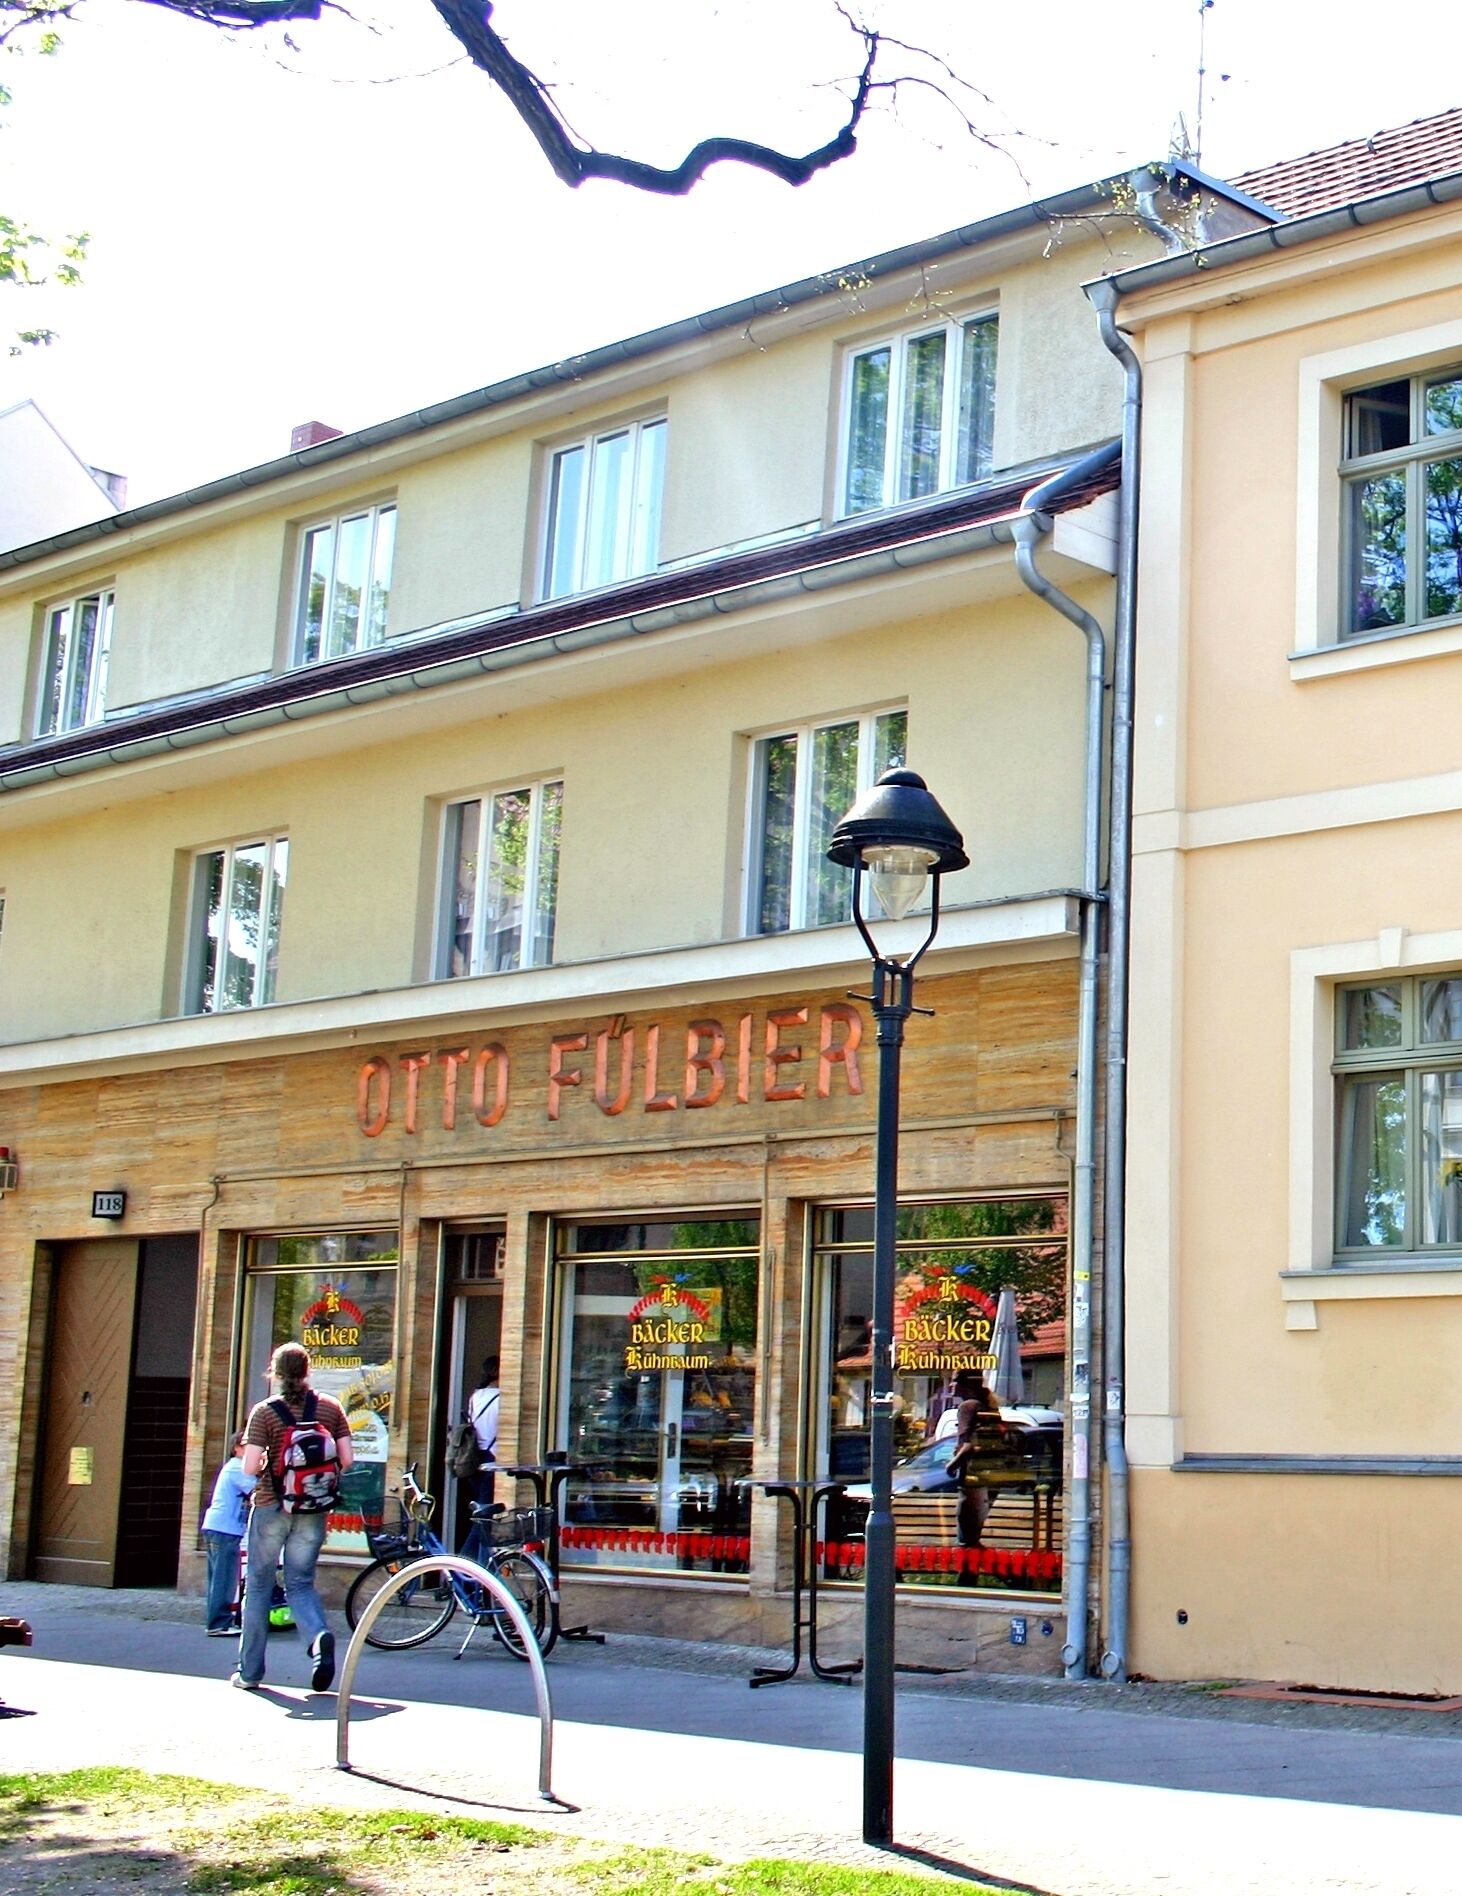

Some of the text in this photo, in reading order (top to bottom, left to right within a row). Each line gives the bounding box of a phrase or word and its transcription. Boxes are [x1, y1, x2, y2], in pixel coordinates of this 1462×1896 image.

[357, 1002, 864, 1138] OTTO FÜLBIER
[98, 1197, 122, 1211] 118
[311, 1354, 362, 1370] ühnbaum
